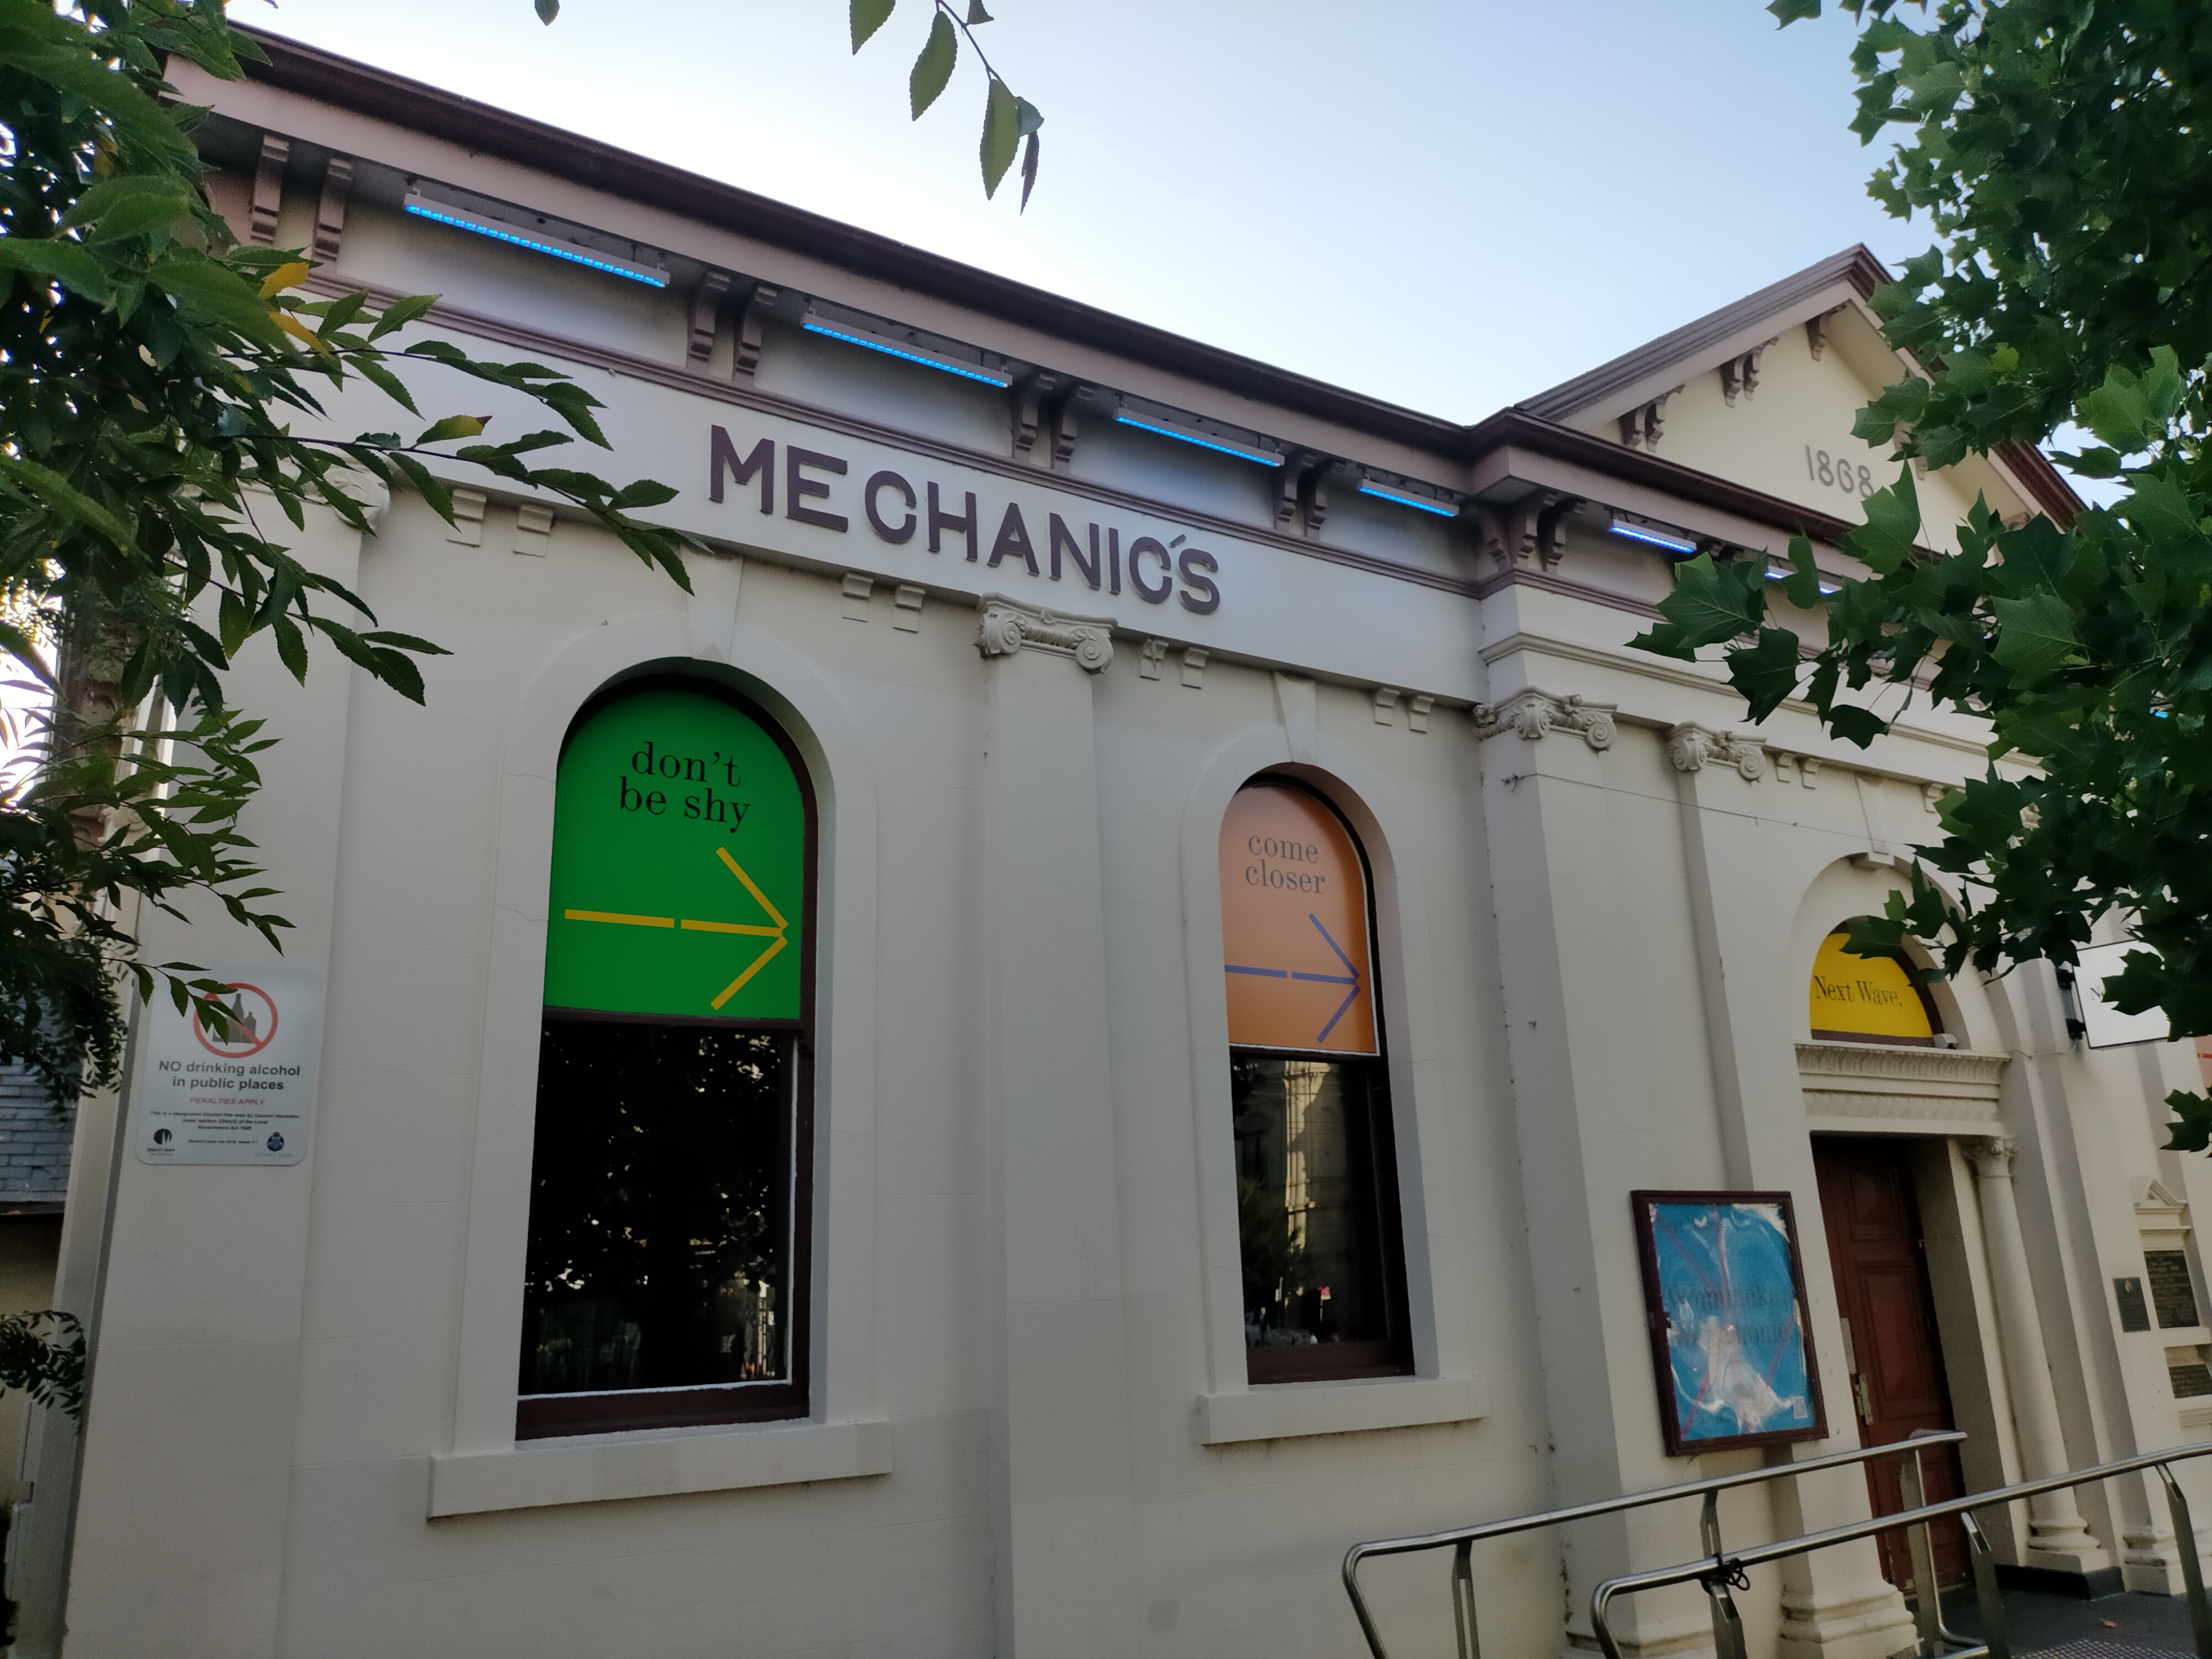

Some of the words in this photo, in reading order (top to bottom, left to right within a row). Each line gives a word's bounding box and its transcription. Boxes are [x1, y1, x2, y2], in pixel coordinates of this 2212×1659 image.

[1805, 445, 1875, 499] 1868
[709, 425, 1221, 614] MECHANIC'S
[632, 741, 741, 787] don't
[618, 776, 666, 815] be
[684, 787, 752, 833] shy
[1248, 836, 1318, 863] come
[1245, 859, 1325, 894] closer
[1813, 975, 1854, 1002] Next
[159, 1061, 181, 1071] NO
[186, 1062, 245, 1076] drinking
[249, 1064, 300, 1076] alcohol
[173, 1076, 185, 1087] in
[190, 1077, 234, 1089] public
[239, 1078, 284, 1091] places
